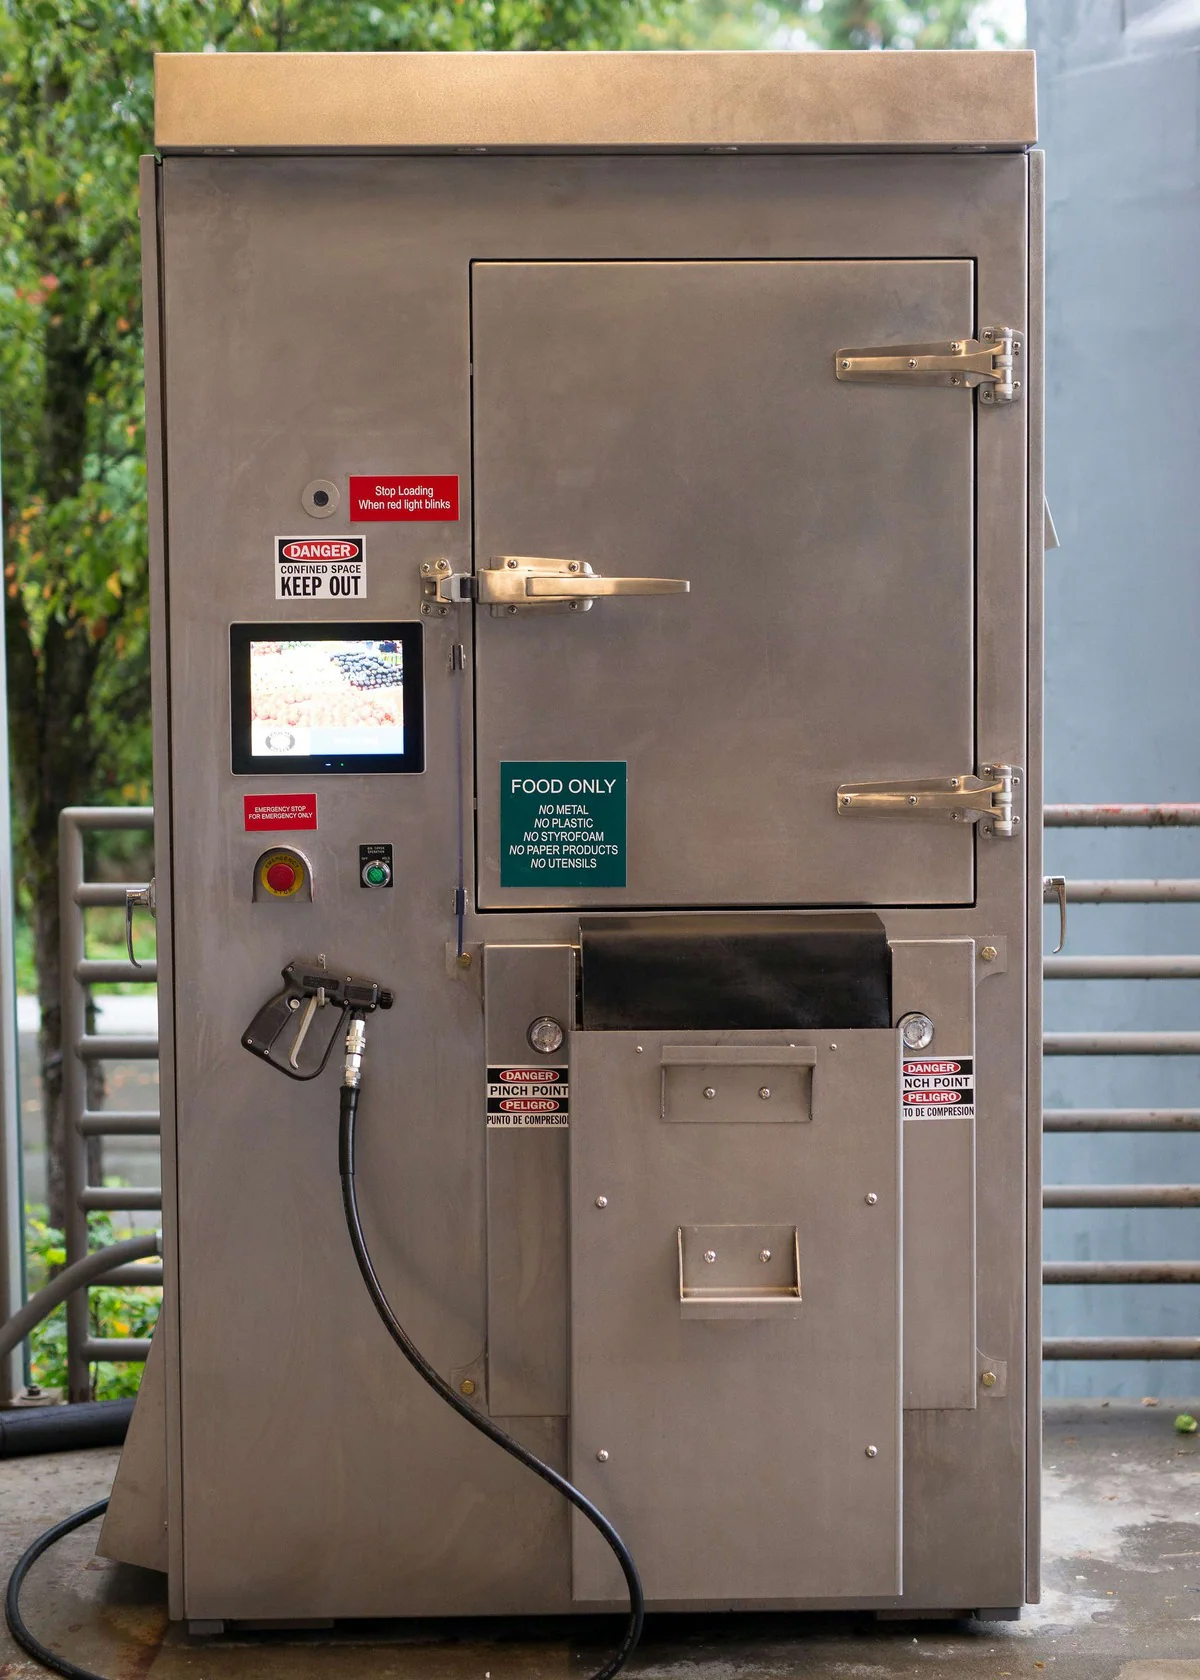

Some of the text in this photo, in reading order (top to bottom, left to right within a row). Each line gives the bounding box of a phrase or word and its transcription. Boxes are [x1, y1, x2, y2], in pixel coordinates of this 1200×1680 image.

[375, 486, 433, 498] Stop Loading
[358, 499, 450, 512] When red light blinks
[290, 544, 350, 557] DANGER
[280, 564, 361, 574] CONFINED SPACE
[281, 576, 361, 596] KEEP OUT
[511, 779, 616, 794] FOOD ONLY
[538, 805, 589, 815] NO METAL
[534, 818, 593, 828] NO PLASTIC
[523, 832, 604, 842] NO STYROFOAM
[509, 845, 618, 855] NO PAPER PRODUCTS
[265, 856, 299, 868] EMERGENCY
[530, 858, 597, 868] NO UTENSILS
[908, 1064, 955, 1072] DANGER
[506, 1072, 553, 1080] DANGER
[934, 1078, 970, 1087] POINT
[490, 1086, 568, 1095] PINCH POINT
[908, 1093, 957, 1102] PELIGRO
[506, 1101, 554, 1110] PELIGRO
[916, 1108, 925, 1116] DE
[927, 1107, 974, 1116] COMPRESION
[487, 1116, 510, 1124] PUNTO
[513, 1116, 522, 1124] DE
